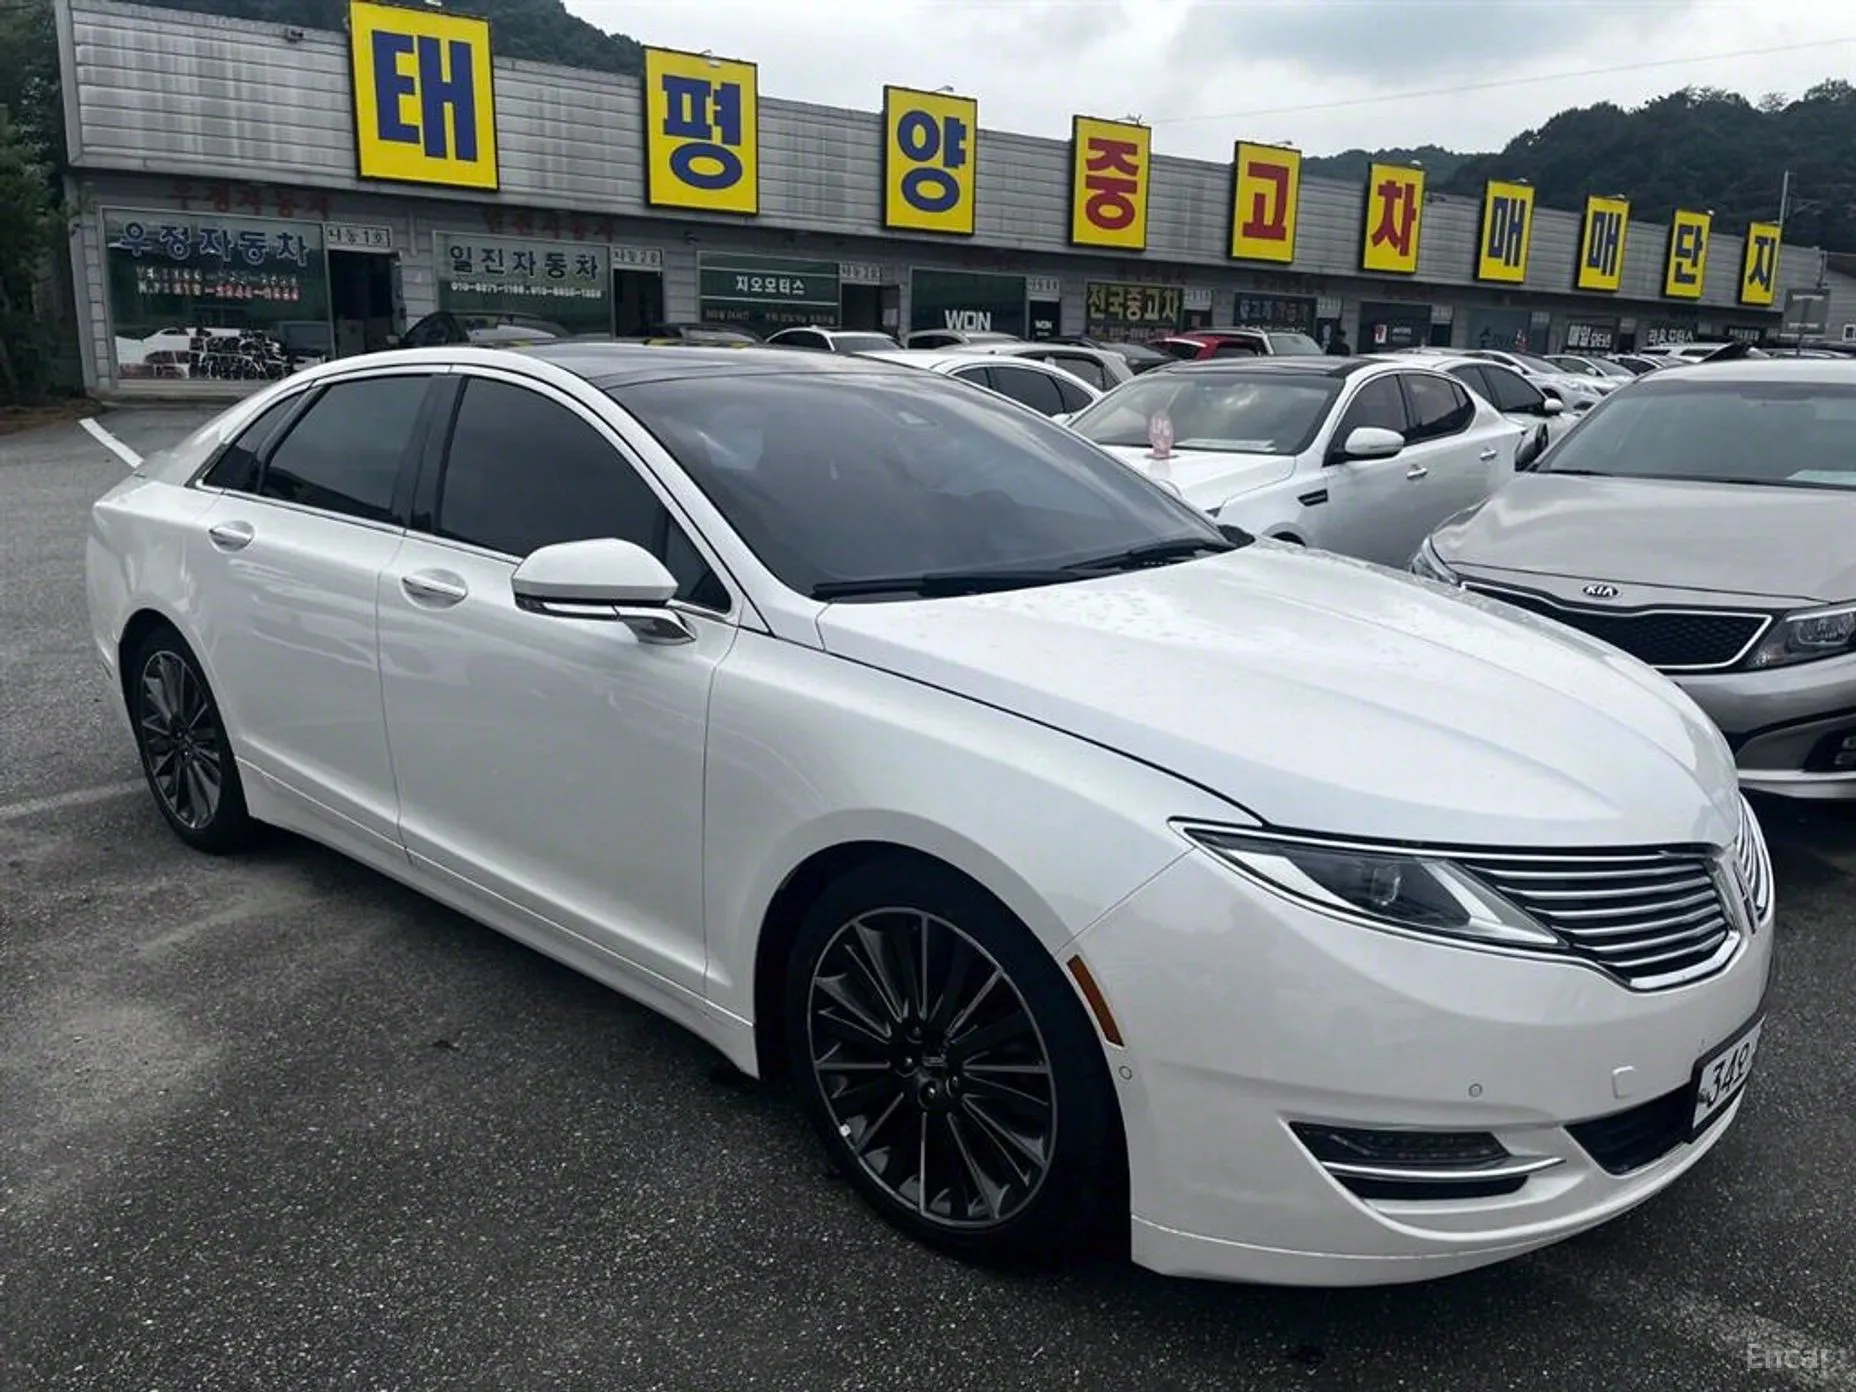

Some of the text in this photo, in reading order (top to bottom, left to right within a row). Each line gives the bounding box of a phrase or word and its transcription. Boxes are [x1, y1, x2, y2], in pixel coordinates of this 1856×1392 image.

[372, 30, 478, 162] 태
[662, 74, 743, 190] 평
[898, 110, 967, 213] 양
[1085, 137, 1140, 230] 중
[1242, 162, 1290, 241] 고
[119, 220, 309, 266] 우정자동차
[1371, 179, 1417, 256] 차
[1487, 196, 1527, 267] 매
[1587, 211, 1622, 277] 매
[450, 246, 599, 280] 일진자동차
[736, 275, 805, 296] 지오모터스
[1674, 224, 1704, 284] 단
[1748, 235, 1776, 293] 지
[944, 309, 991, 331] WON
[1088, 284, 1180, 323] 전국중고차
